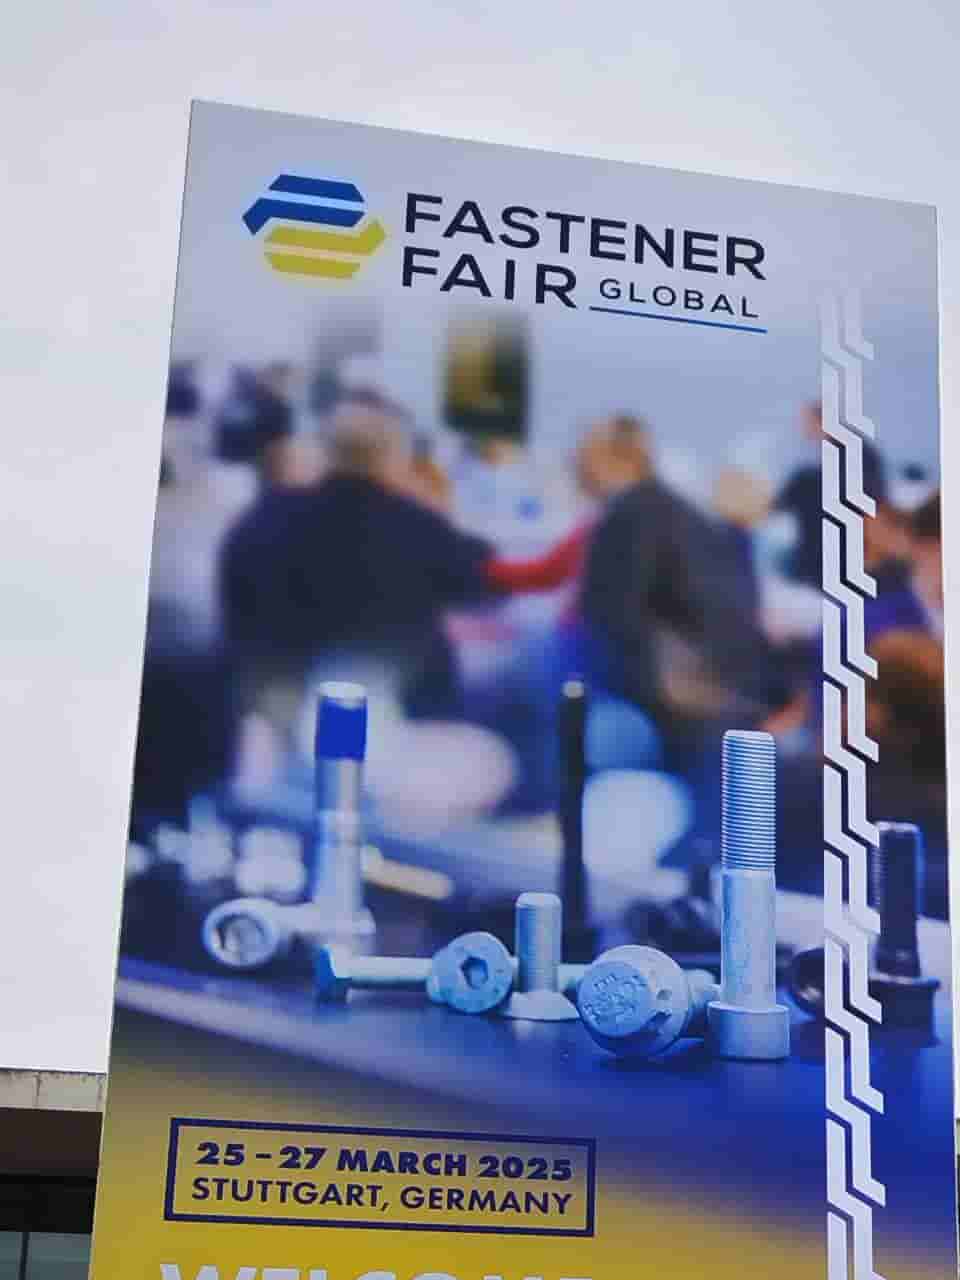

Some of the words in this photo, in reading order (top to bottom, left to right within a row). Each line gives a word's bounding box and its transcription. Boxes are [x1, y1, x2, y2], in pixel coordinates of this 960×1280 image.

[405, 192, 767, 281] FASTENER
[402, 245, 578, 309] FAIR
[599, 278, 759, 318] GLOBAL
[195, 1141, 245, 1167] 25
[279, 1145, 327, 1169] 27
[336, 1148, 468, 1177] MARCH
[478, 1155, 572, 1181] 2025
[191, 1177, 390, 1212] STUTTGART,
[400, 1185, 574, 1215] GERMANY
